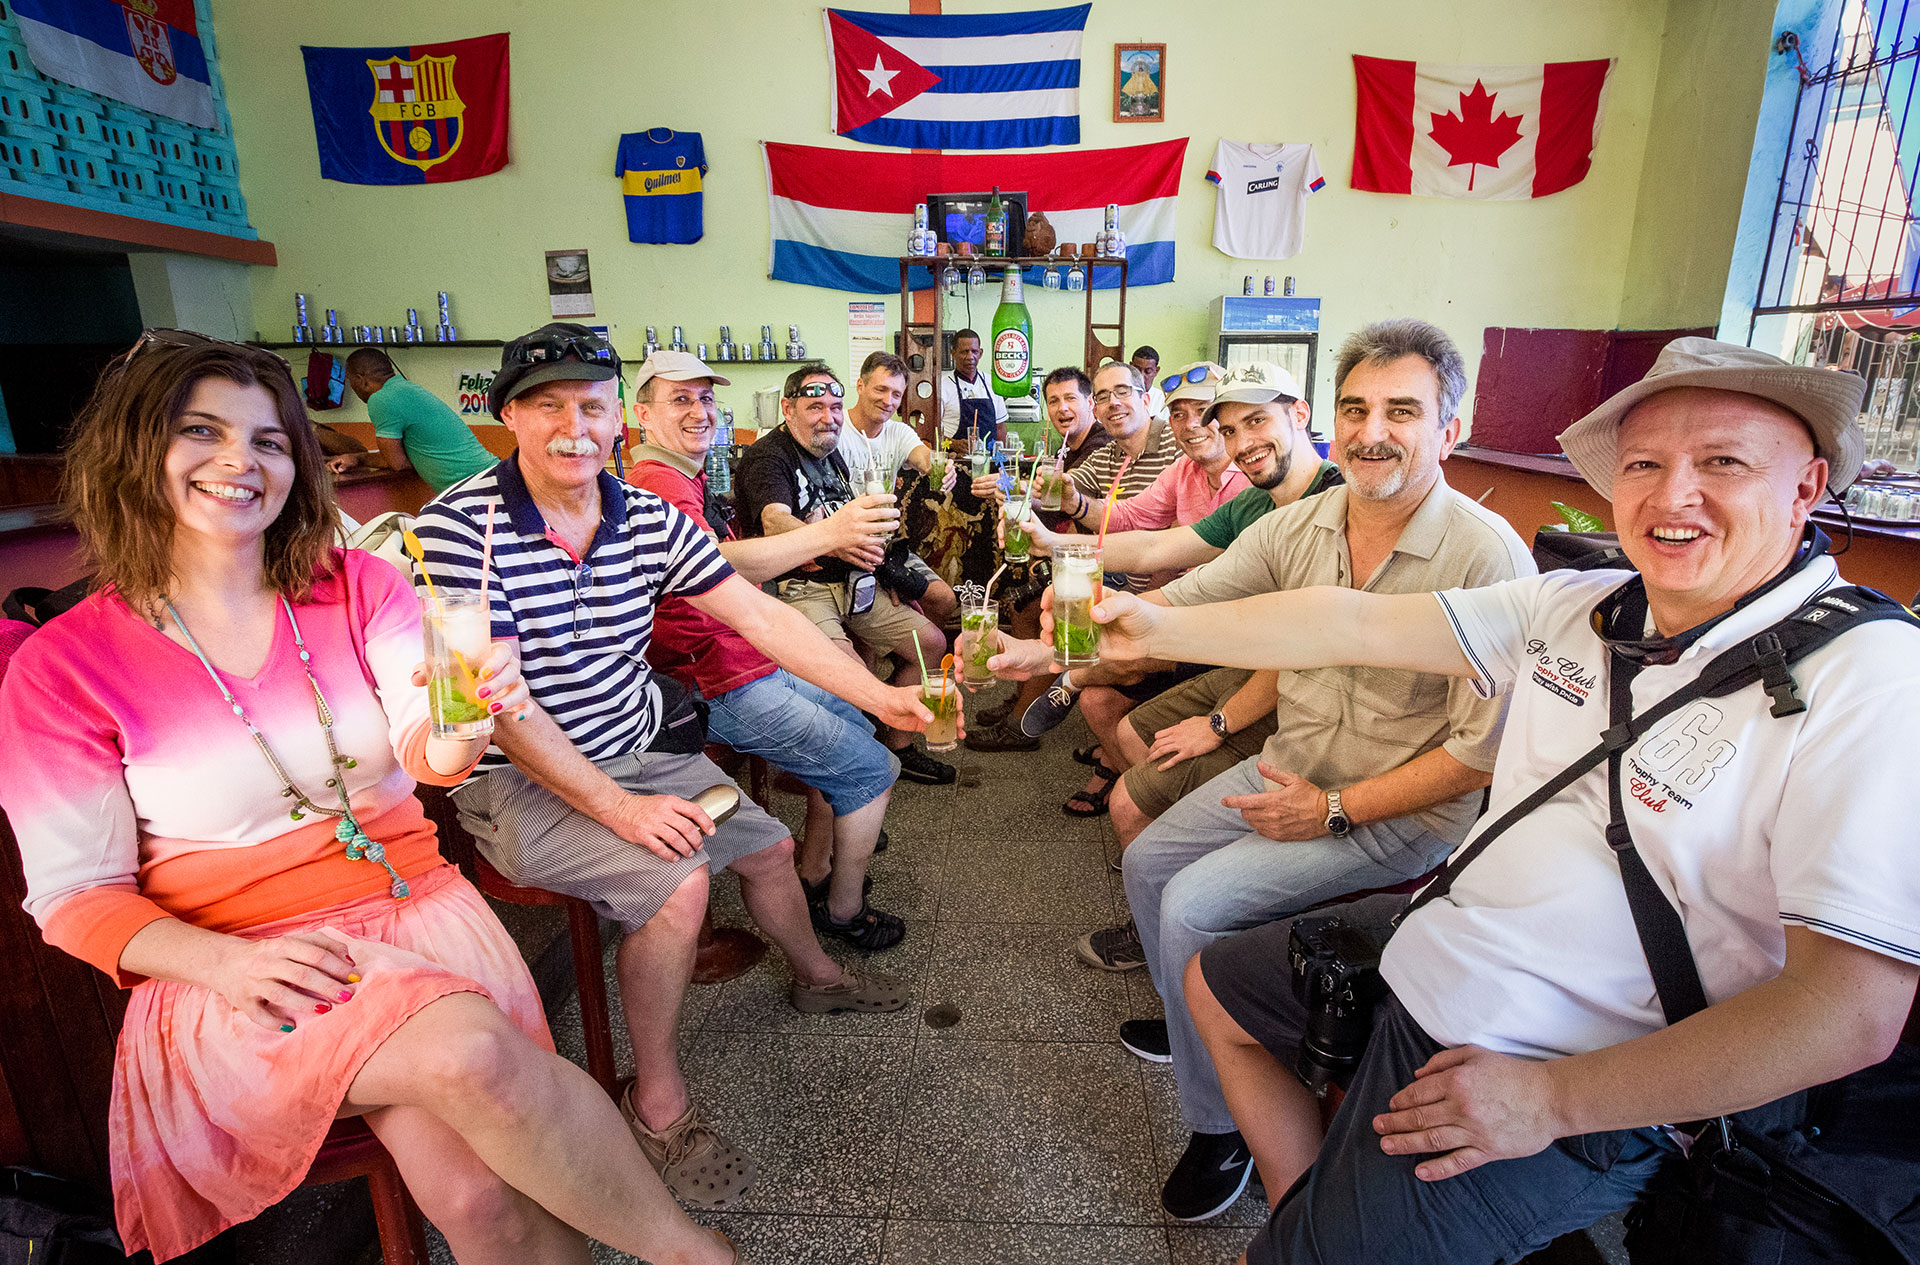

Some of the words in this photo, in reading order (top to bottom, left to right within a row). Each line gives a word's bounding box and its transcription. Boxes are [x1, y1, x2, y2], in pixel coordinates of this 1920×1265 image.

[399, 103, 436, 118] FCB
[644, 172, 681, 193] Quilmes
[458, 373, 492, 395] Feliz
[460, 394, 492, 413] 201
[1819, 596, 1860, 612] Nikon
[1535, 664, 1560, 682] ophy
[1561, 678, 1589, 698] Team
[1556, 657, 1597, 690] Club
[1544, 681, 1560, 694] with
[1638, 701, 1737, 795] 63
[1628, 757, 1660, 787] Trophy
[1660, 783, 1694, 811] Team
[1629, 777, 1669, 813] Club
